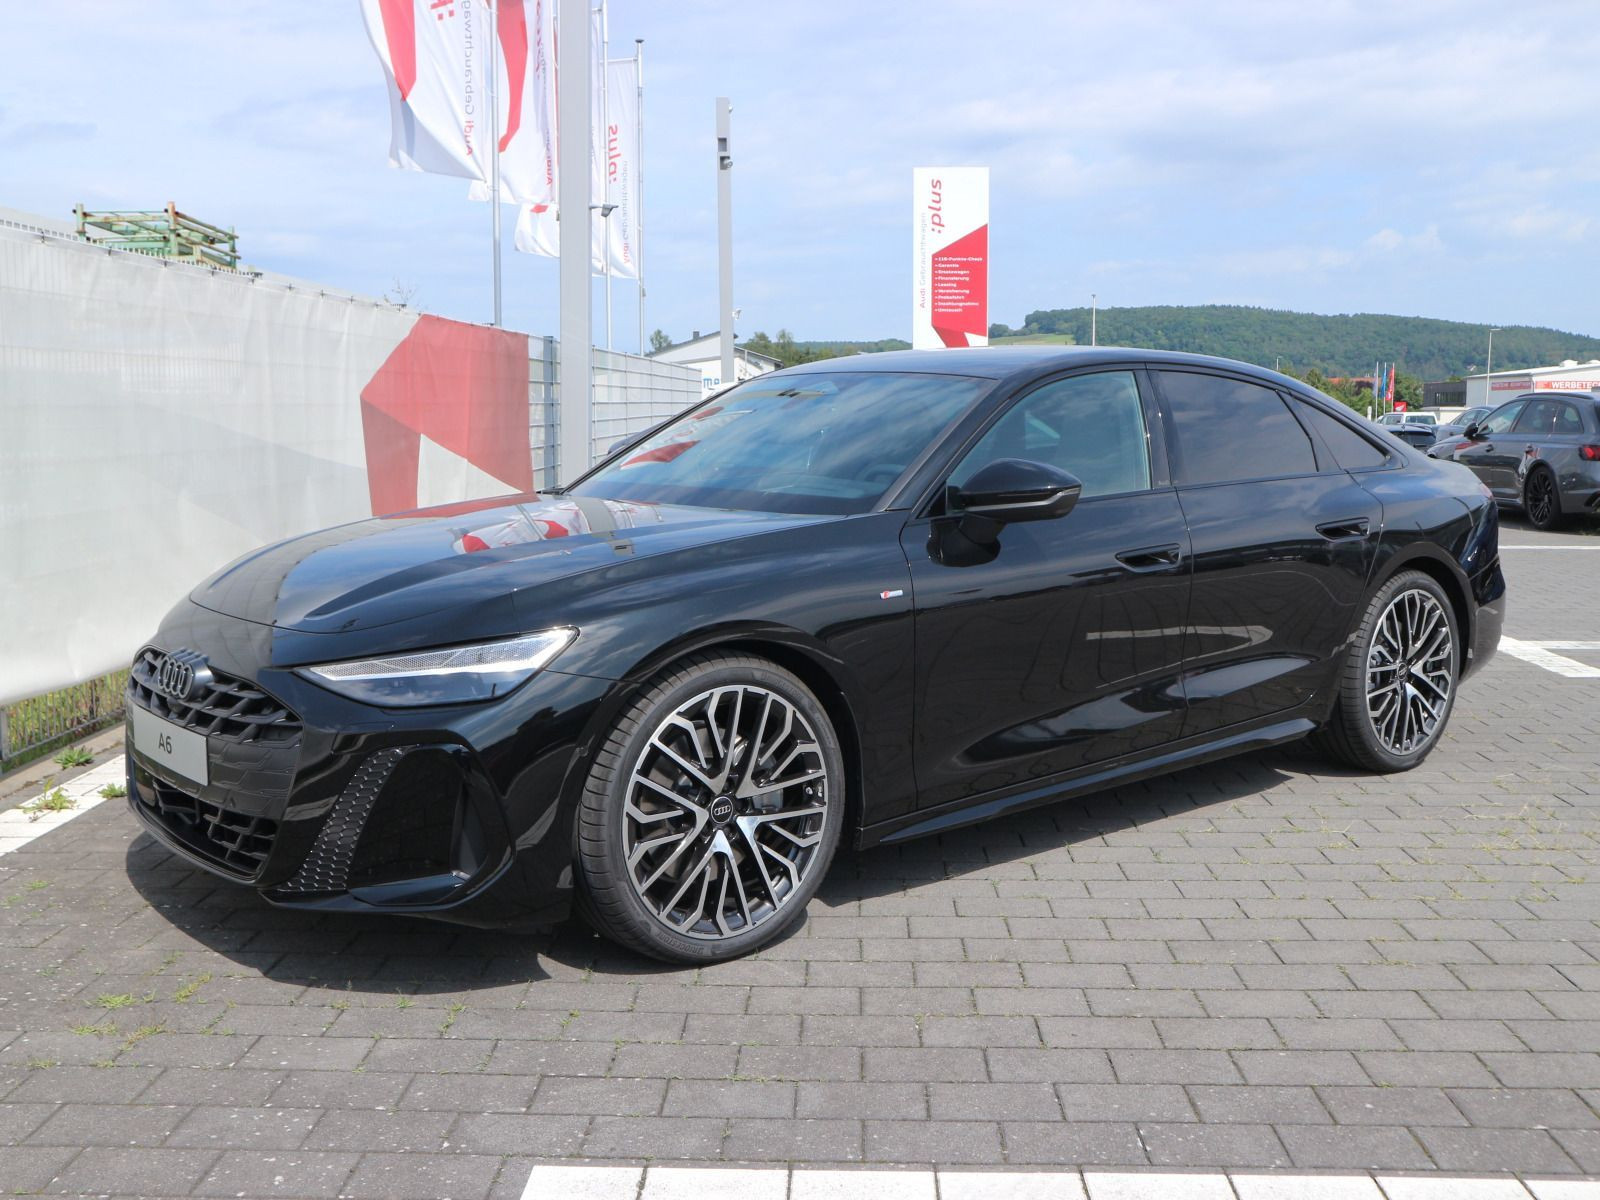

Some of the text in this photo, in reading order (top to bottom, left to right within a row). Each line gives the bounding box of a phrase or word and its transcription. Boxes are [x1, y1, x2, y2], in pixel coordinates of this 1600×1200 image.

[928, 179, 945, 233] :plus
[1551, 381, 1600, 389] WERBETEC
[158, 732, 172, 754] A6
